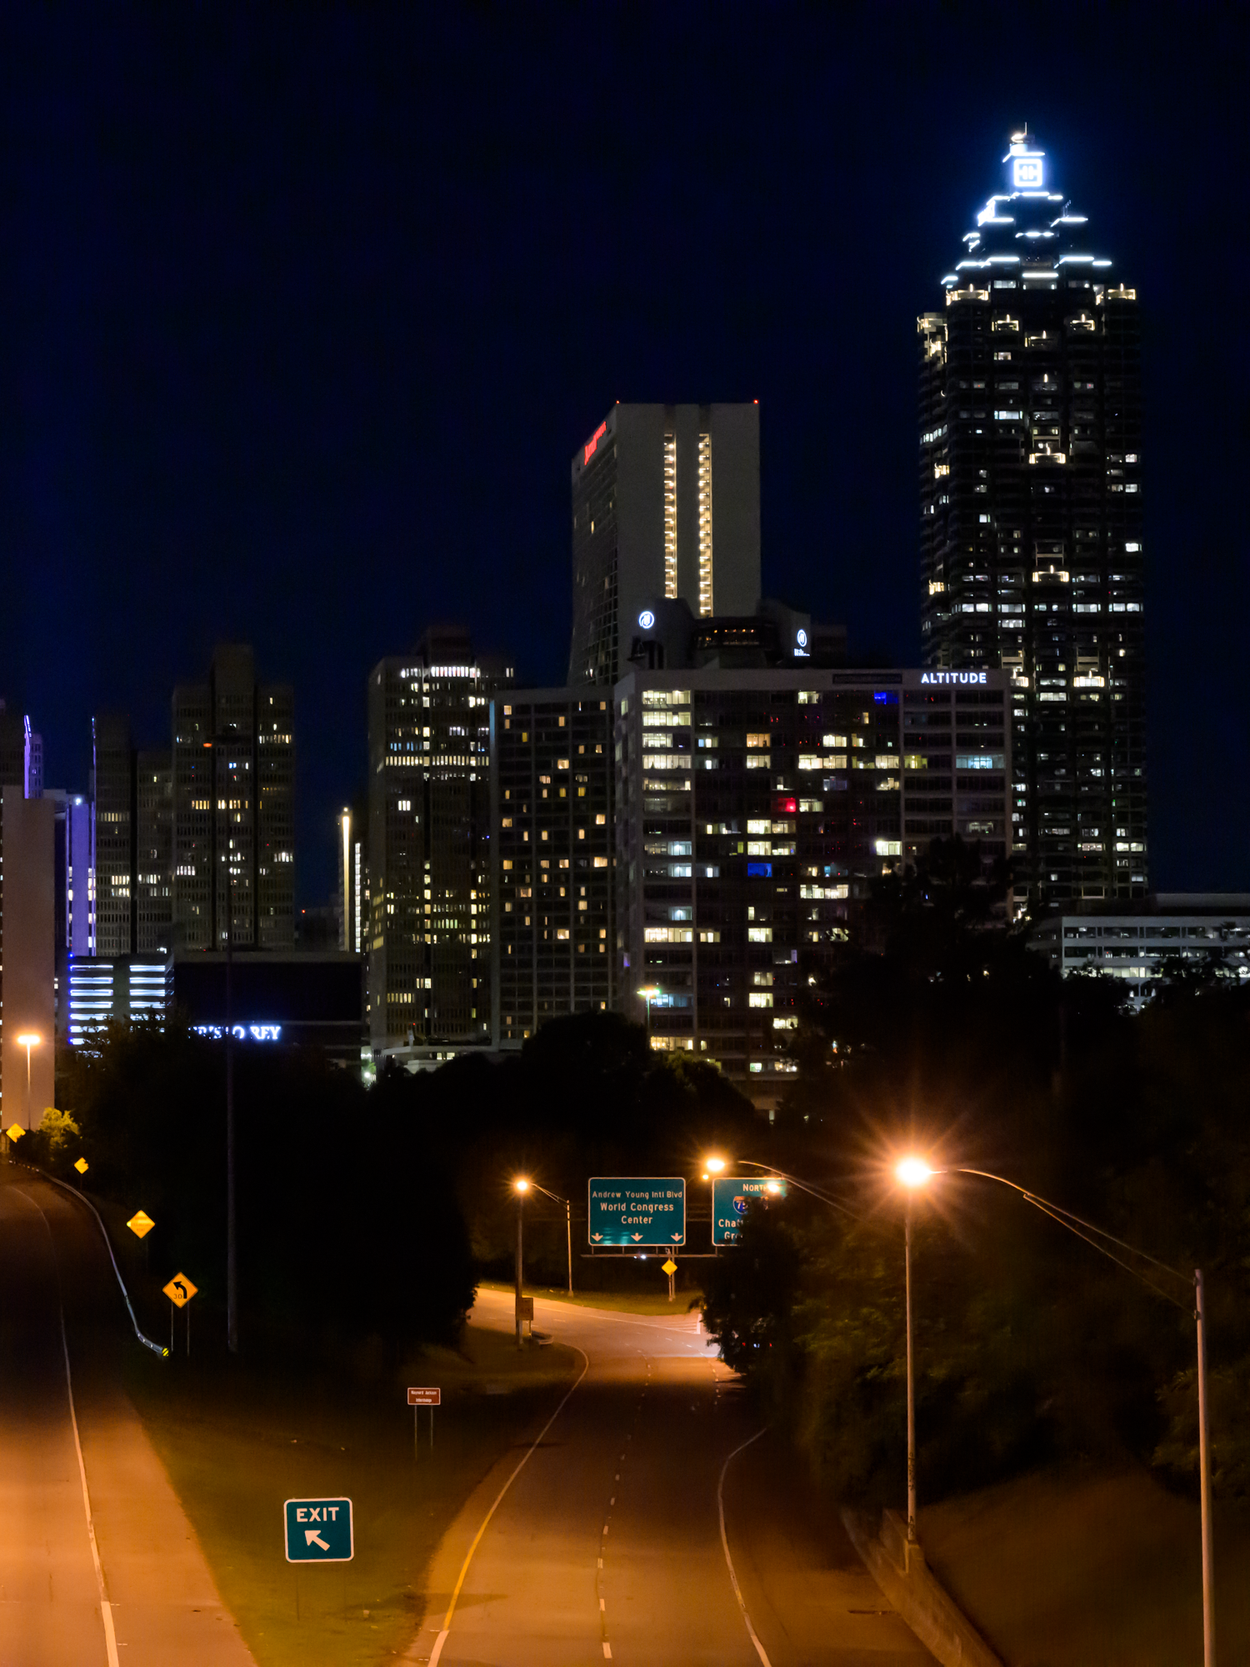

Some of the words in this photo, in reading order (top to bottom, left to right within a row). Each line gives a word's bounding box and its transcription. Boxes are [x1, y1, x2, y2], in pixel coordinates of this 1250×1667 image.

[920, 672, 987, 684] ALTITUDE
[591, 1190, 622, 1199] Andrew
[625, 1190, 650, 1200] Young
[666, 1190, 683, 1198] Blvd
[600, 1202, 627, 1212] World
[630, 1202, 674, 1214] Congress
[621, 1215, 653, 1224] Center
[296, 1507, 340, 1523] EXIT
